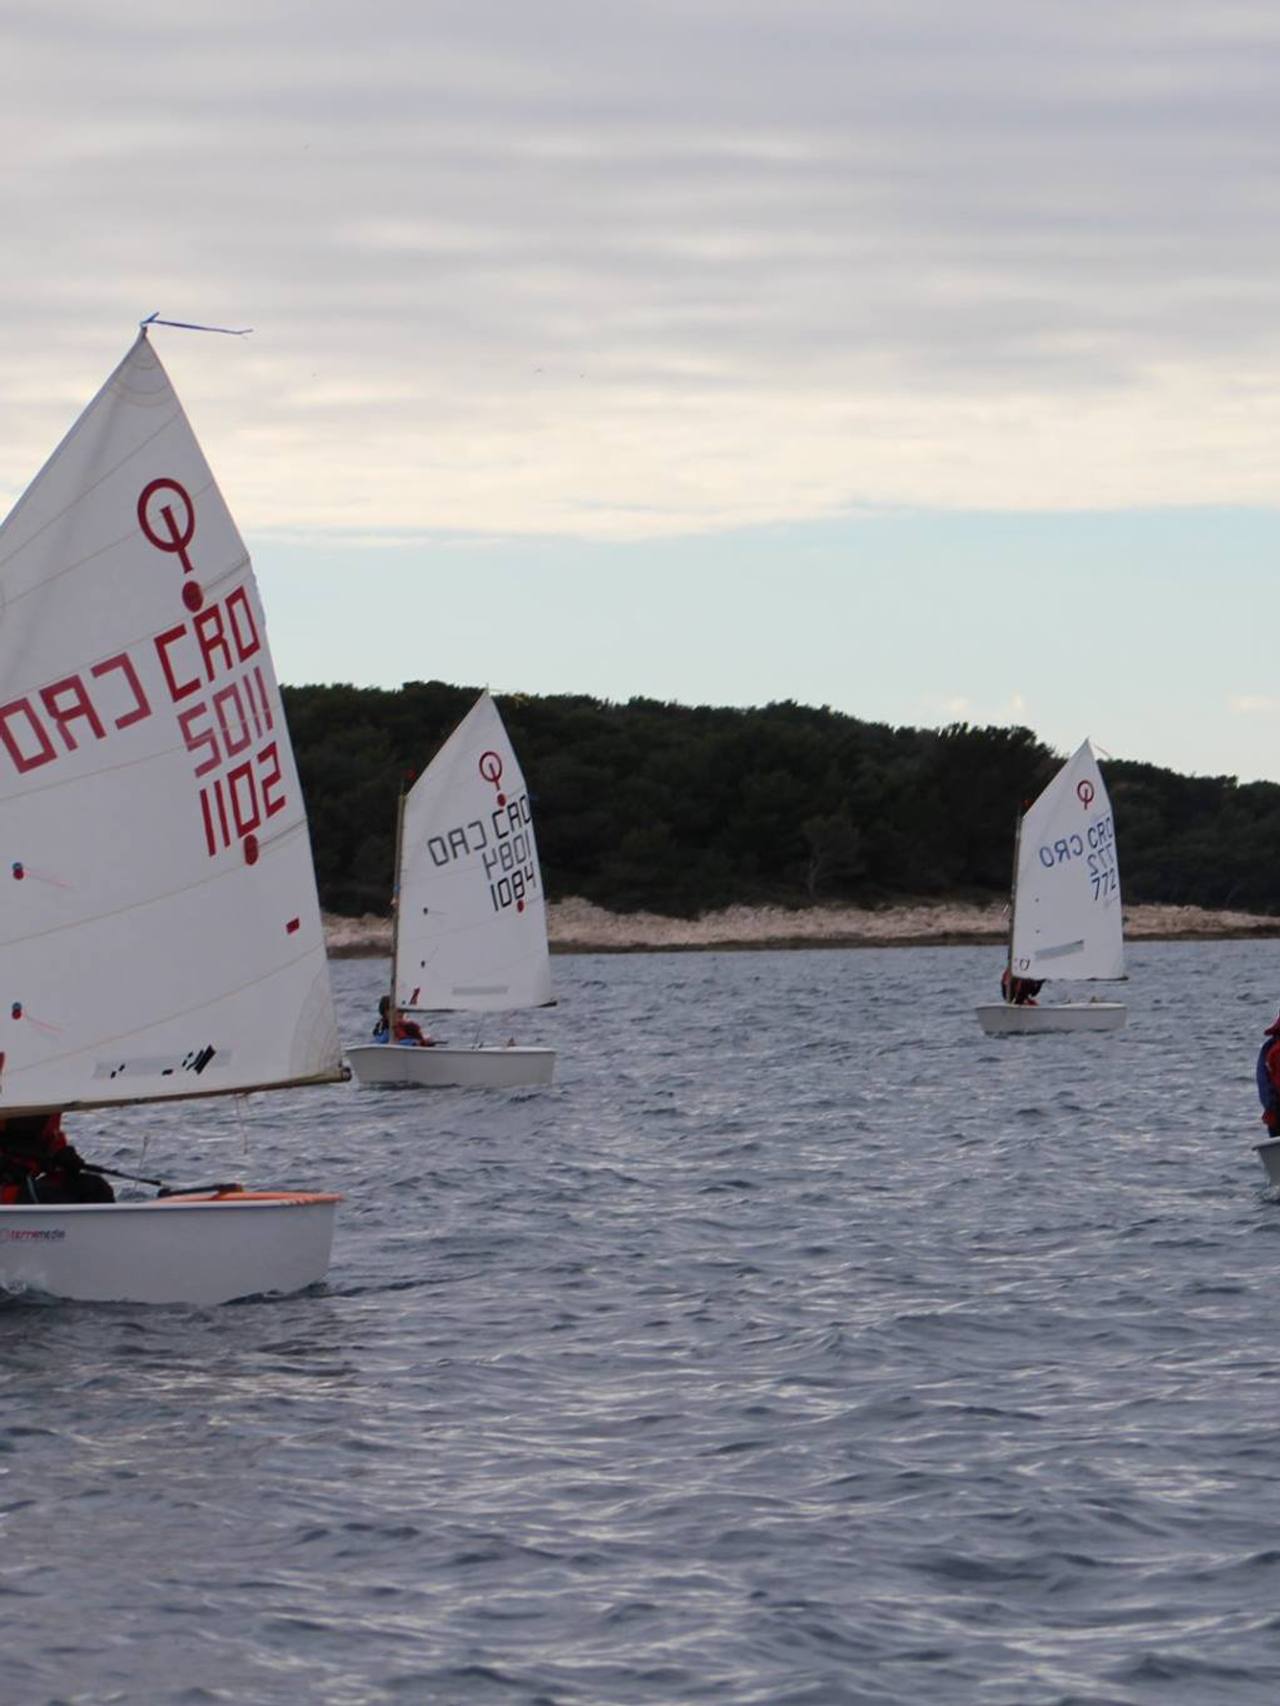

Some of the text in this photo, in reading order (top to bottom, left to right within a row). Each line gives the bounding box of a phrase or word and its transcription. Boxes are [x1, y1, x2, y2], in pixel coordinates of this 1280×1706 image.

[154, 585, 261, 703] CRO
[200, 741, 287, 857] 1102
[490, 861, 537, 912] 1084
[1092, 868, 1117, 901] 772
